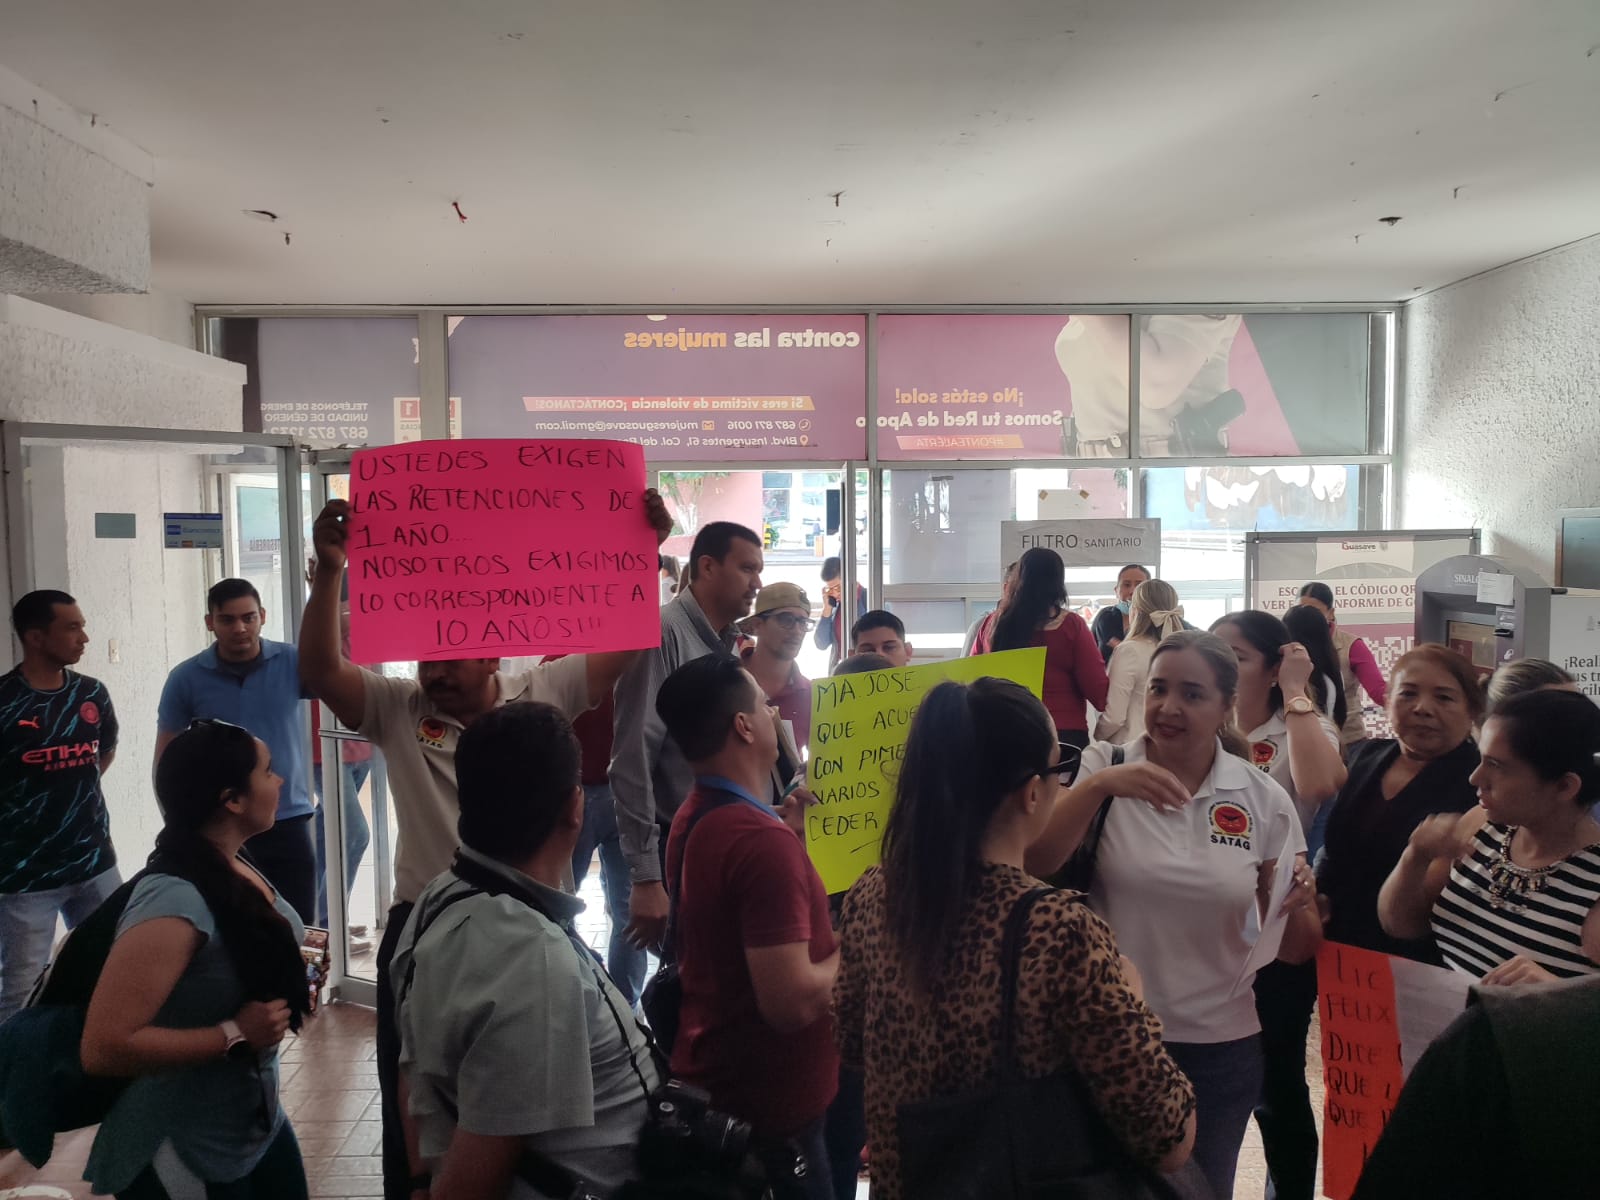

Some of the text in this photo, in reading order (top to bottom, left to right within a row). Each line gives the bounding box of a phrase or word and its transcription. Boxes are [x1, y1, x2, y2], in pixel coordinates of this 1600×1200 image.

[359, 444, 626, 481] USTEDES EXIGEN
[352, 484, 634, 514] LAS RETENCIONES DE
[354, 524, 388, 550] 1
[1022, 534, 1142, 549] FILTRO SANITARIO
[362, 549, 649, 580] NOSOTROS EXIGIMOS
[393, 583, 621, 614] CORRESPONDIENTE
[630, 583, 646, 603] A
[1335, 586, 1348, 596] EL
[1350, 583, 1398, 595] CÓDIGO
[1262, 600, 1286, 610] VER
[1387, 597, 1403, 607] DE
[435, 618, 469, 647] 10
[816, 720, 857, 744] QUE
[22, 740, 100, 764] ETIHAD
[813, 756, 844, 780] CON
[808, 811, 879, 841] CEDER
[1210, 834, 1251, 851] SATAG
[1327, 1066, 1370, 1099] QUE
[1327, 1098, 1369, 1129] QUE
